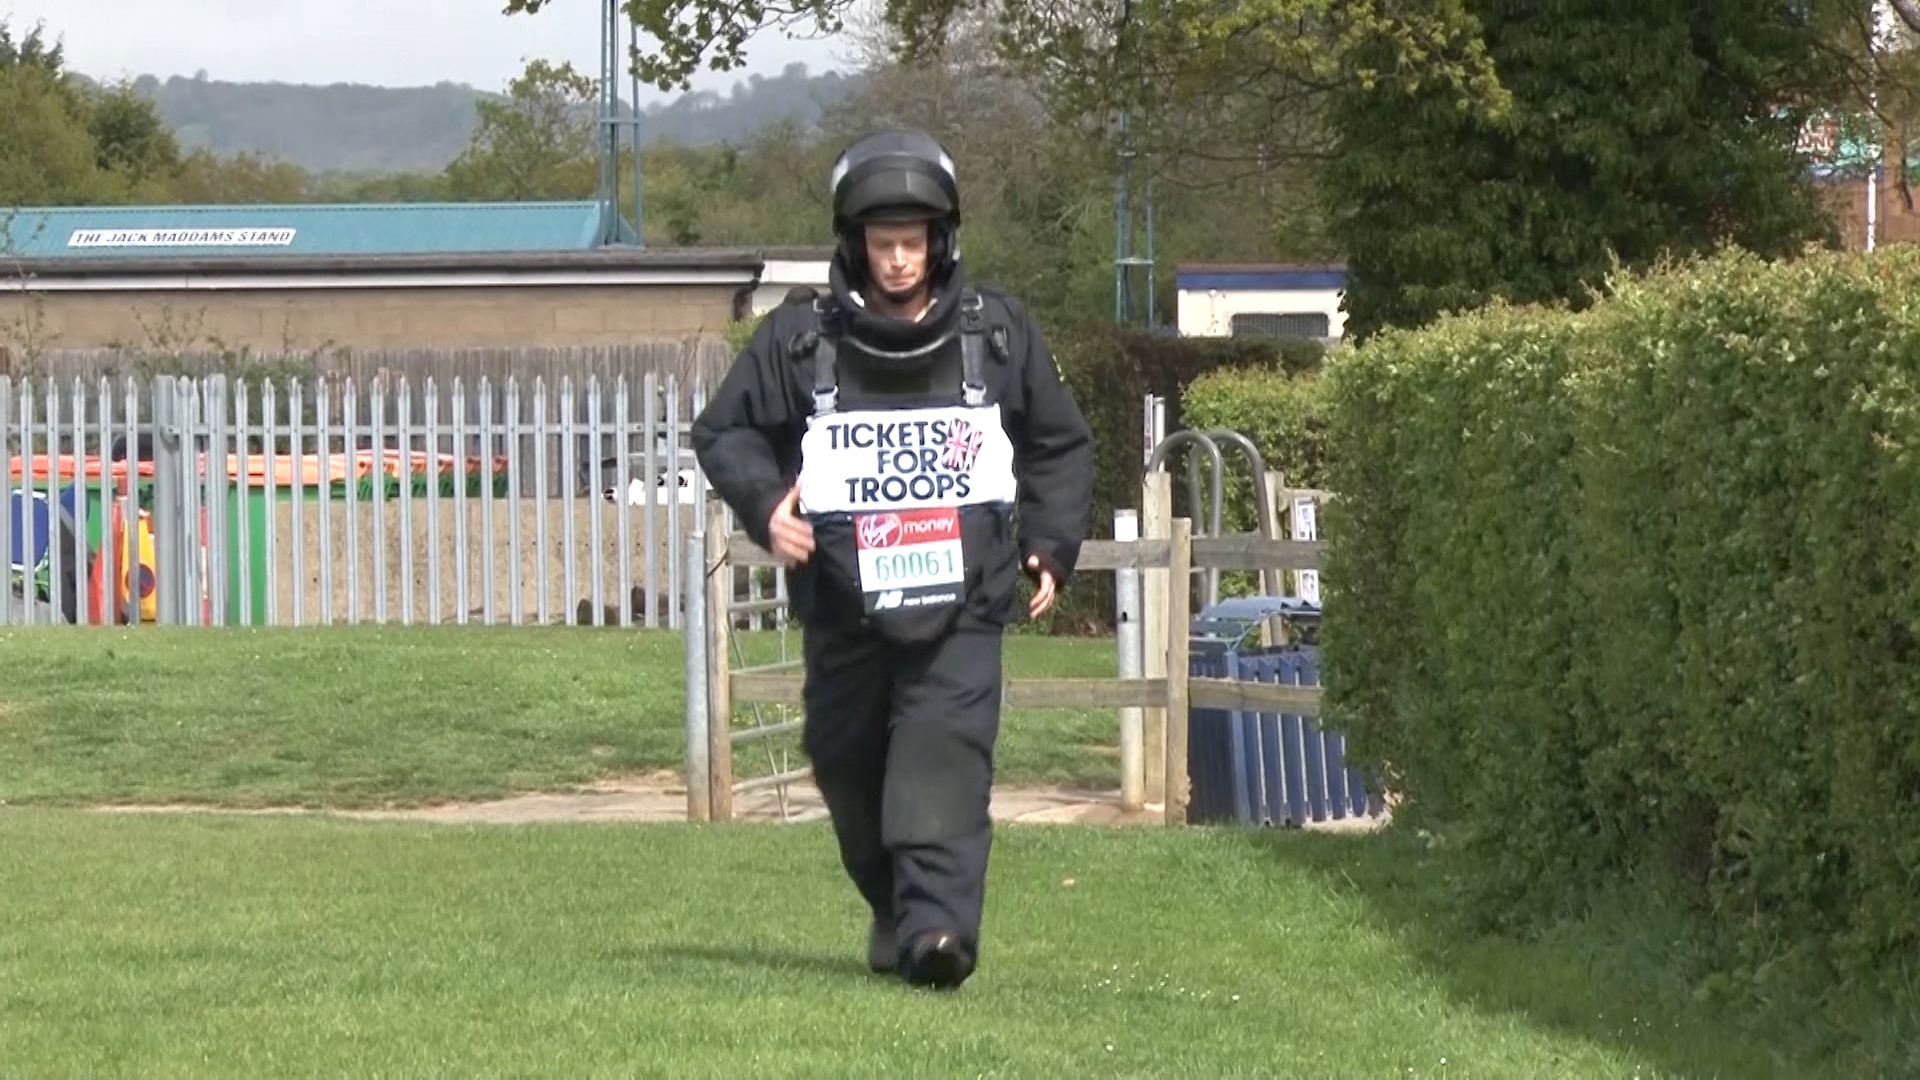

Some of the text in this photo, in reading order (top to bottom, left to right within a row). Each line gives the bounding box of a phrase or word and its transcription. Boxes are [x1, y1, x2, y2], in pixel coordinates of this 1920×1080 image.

[106, 232, 147, 243] JACK
[152, 231, 233, 243] MADDAMS
[237, 230, 291, 242] STAND
[826, 420, 947, 450] TICKETS
[877, 447, 938, 474] FOR
[845, 473, 971, 503] TROOPS
[904, 518, 954, 534] money
[875, 548, 953, 582] 60061
